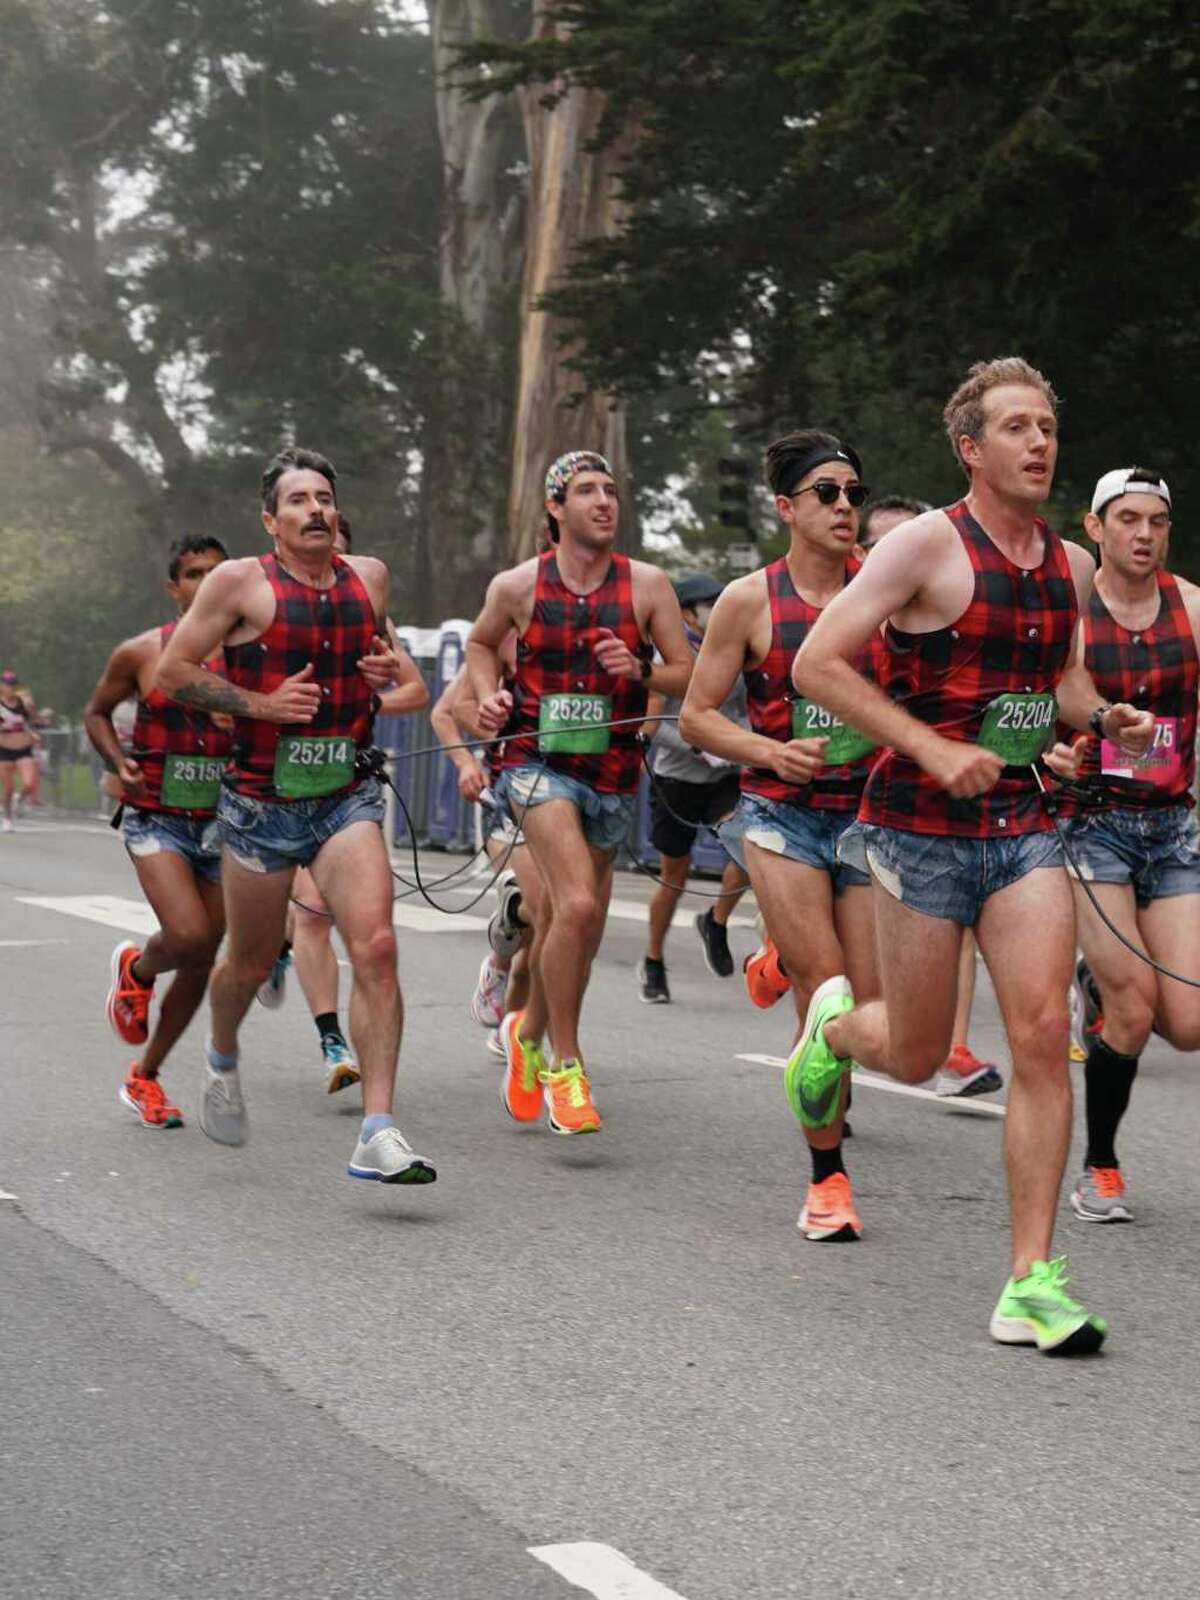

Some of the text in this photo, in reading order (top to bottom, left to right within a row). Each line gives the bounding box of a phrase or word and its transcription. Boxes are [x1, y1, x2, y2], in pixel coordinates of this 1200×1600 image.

[550, 699, 604, 721] 25225
[997, 700, 1054, 729] 25204
[1153, 723, 1174, 748] 75
[288, 741, 347, 765] 25214
